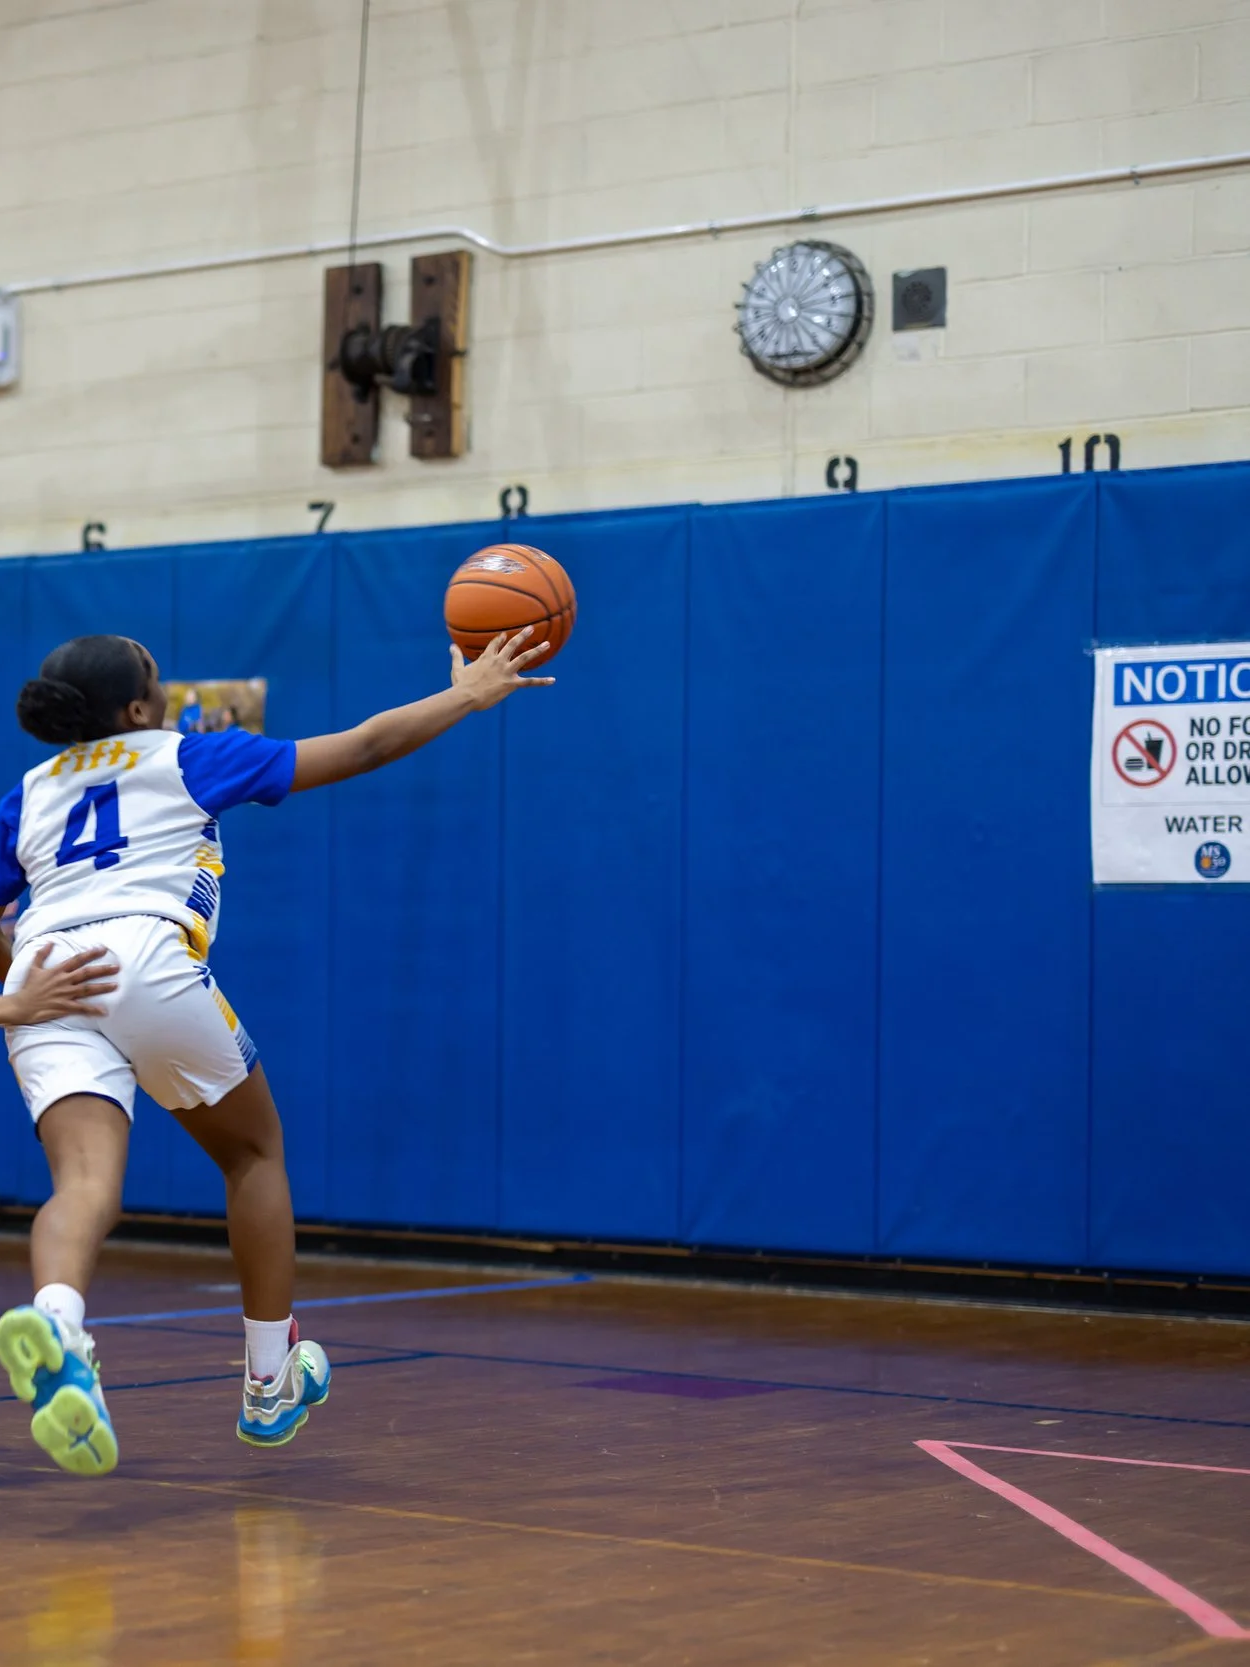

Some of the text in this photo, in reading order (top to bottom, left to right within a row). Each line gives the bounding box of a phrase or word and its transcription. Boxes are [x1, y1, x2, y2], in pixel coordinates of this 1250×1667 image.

[1059, 434, 1119, 474] 10
[308, 501, 336, 534] 7
[1122, 662, 1250, 702] NOTIC
[1190, 717, 1221, 738] NO
[1186, 740, 1250, 761] OR DR
[55, 780, 128, 870] 4
[1165, 815, 1243, 834] WATER
